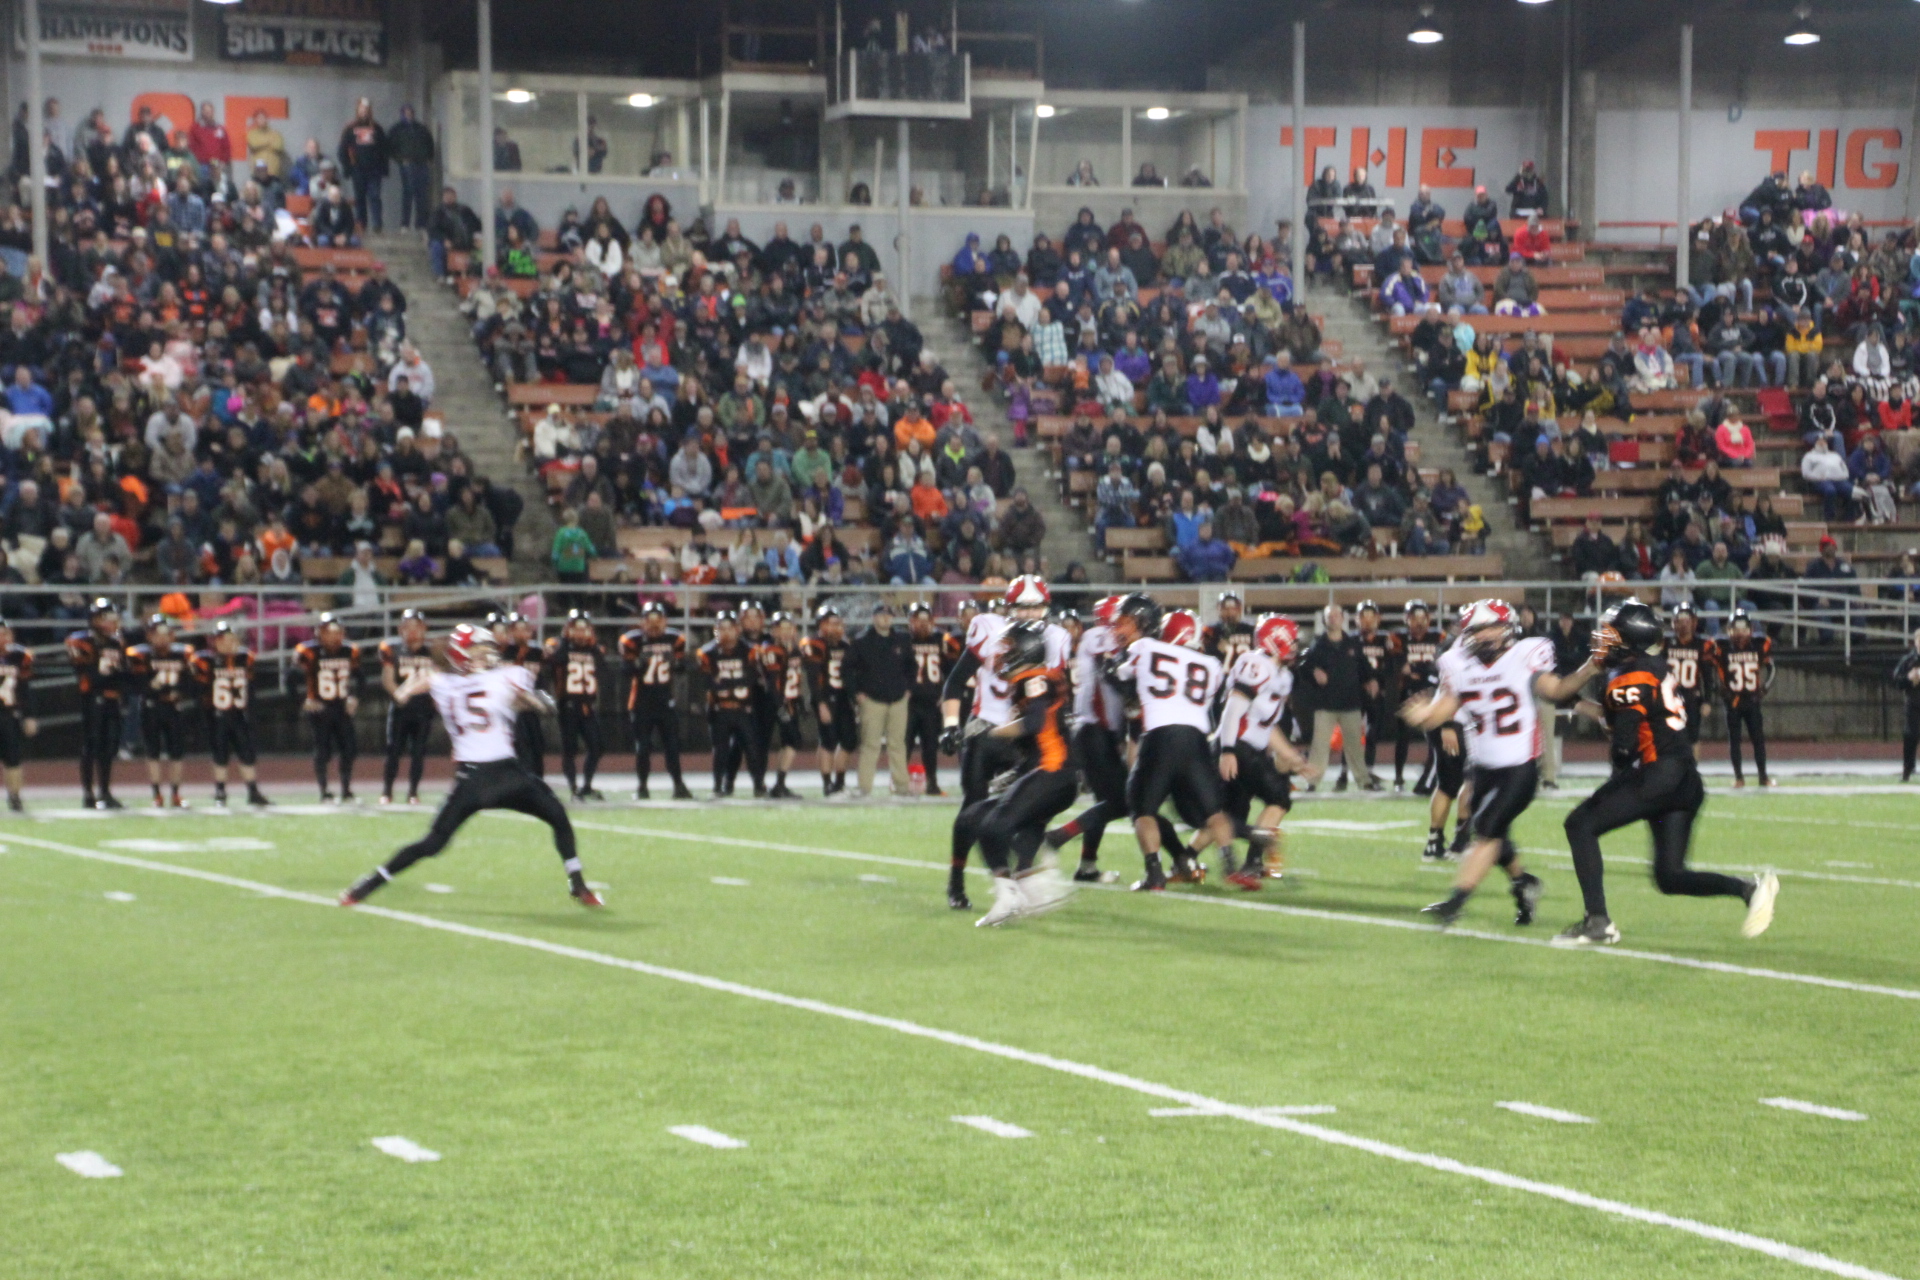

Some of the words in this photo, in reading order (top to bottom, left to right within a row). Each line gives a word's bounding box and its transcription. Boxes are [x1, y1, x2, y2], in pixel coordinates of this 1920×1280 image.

[284, 28, 380, 64] PLACE
[1279, 126, 1477, 188] THE
[1754, 128, 1902, 189] TIG
[212, 678, 249, 711] 63
[566, 661, 597, 694] 25
[1147, 651, 1210, 706] 58
[1728, 662, 1759, 692] 35
